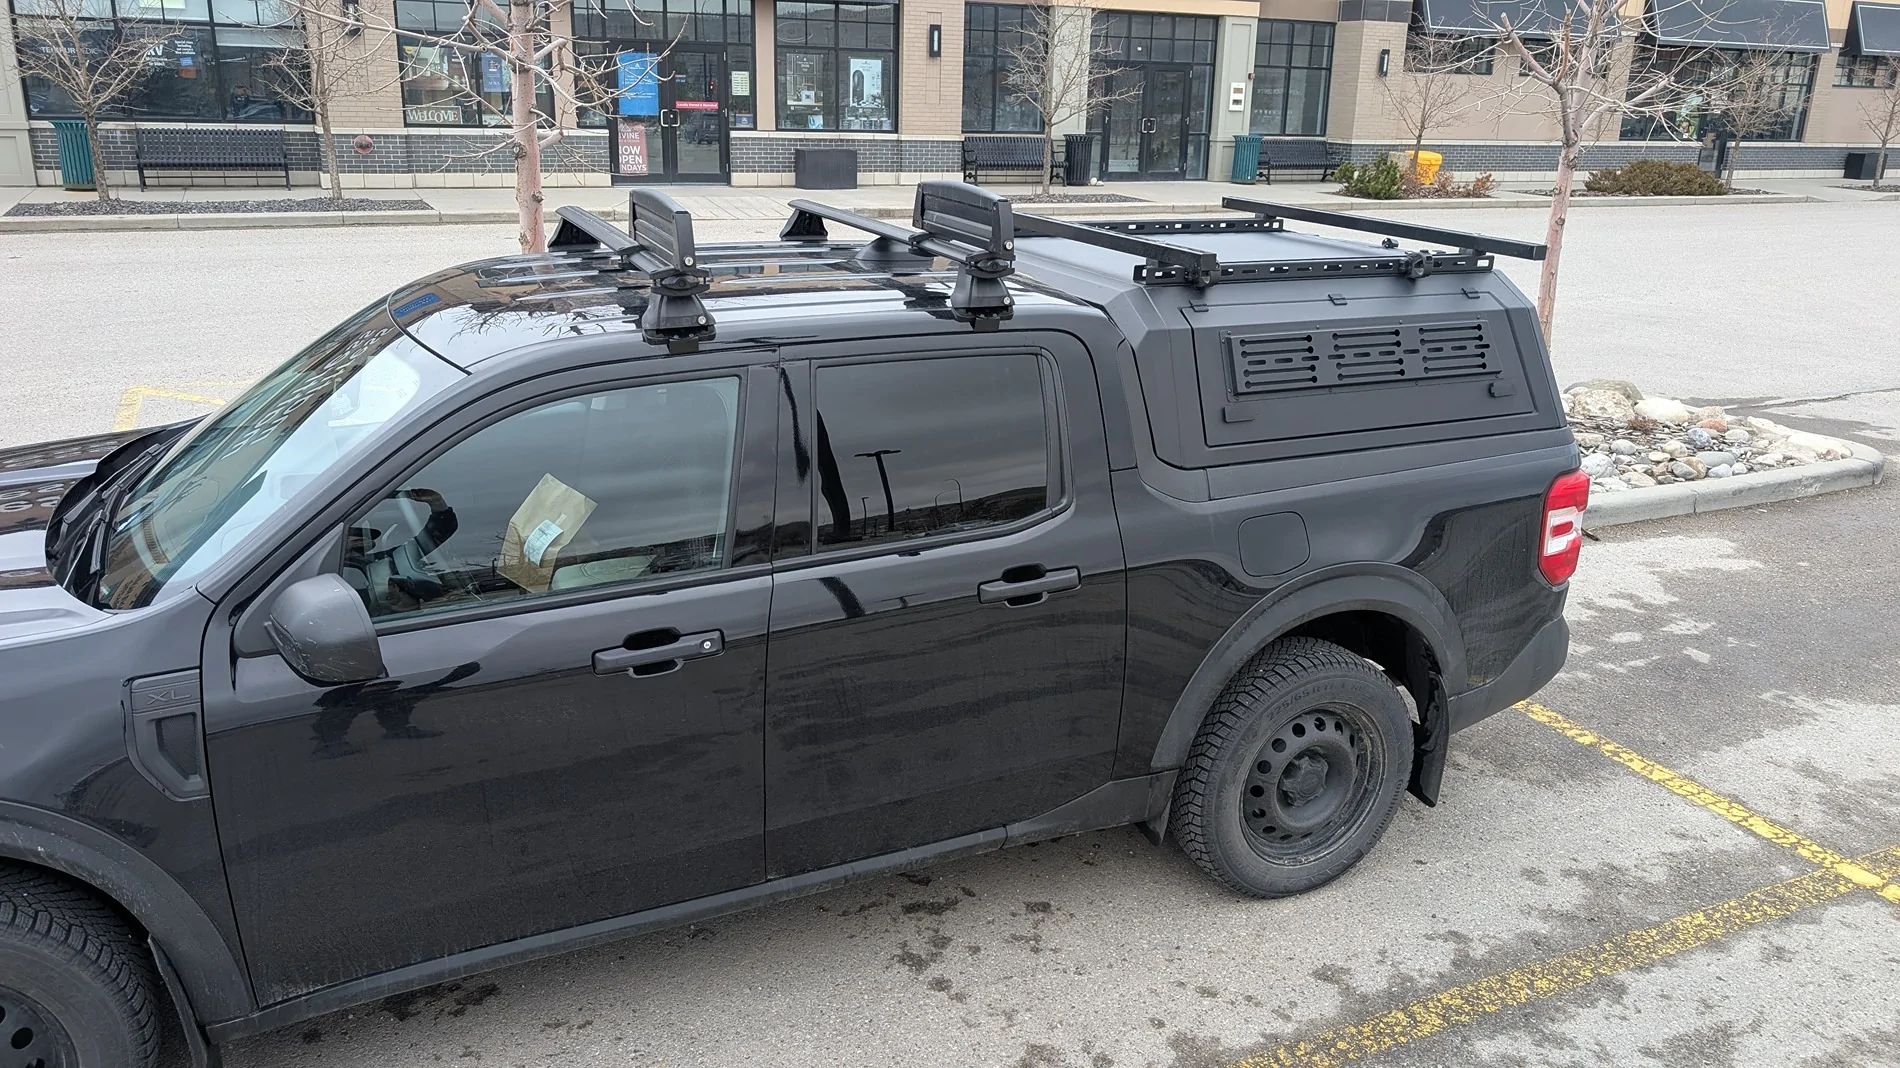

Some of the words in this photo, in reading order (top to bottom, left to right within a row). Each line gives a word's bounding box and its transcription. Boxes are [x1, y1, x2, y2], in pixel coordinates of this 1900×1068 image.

[407, 109, 458, 123] WELCOME
[619, 155, 643, 164] PEN
[147, 690, 192, 705] XL
